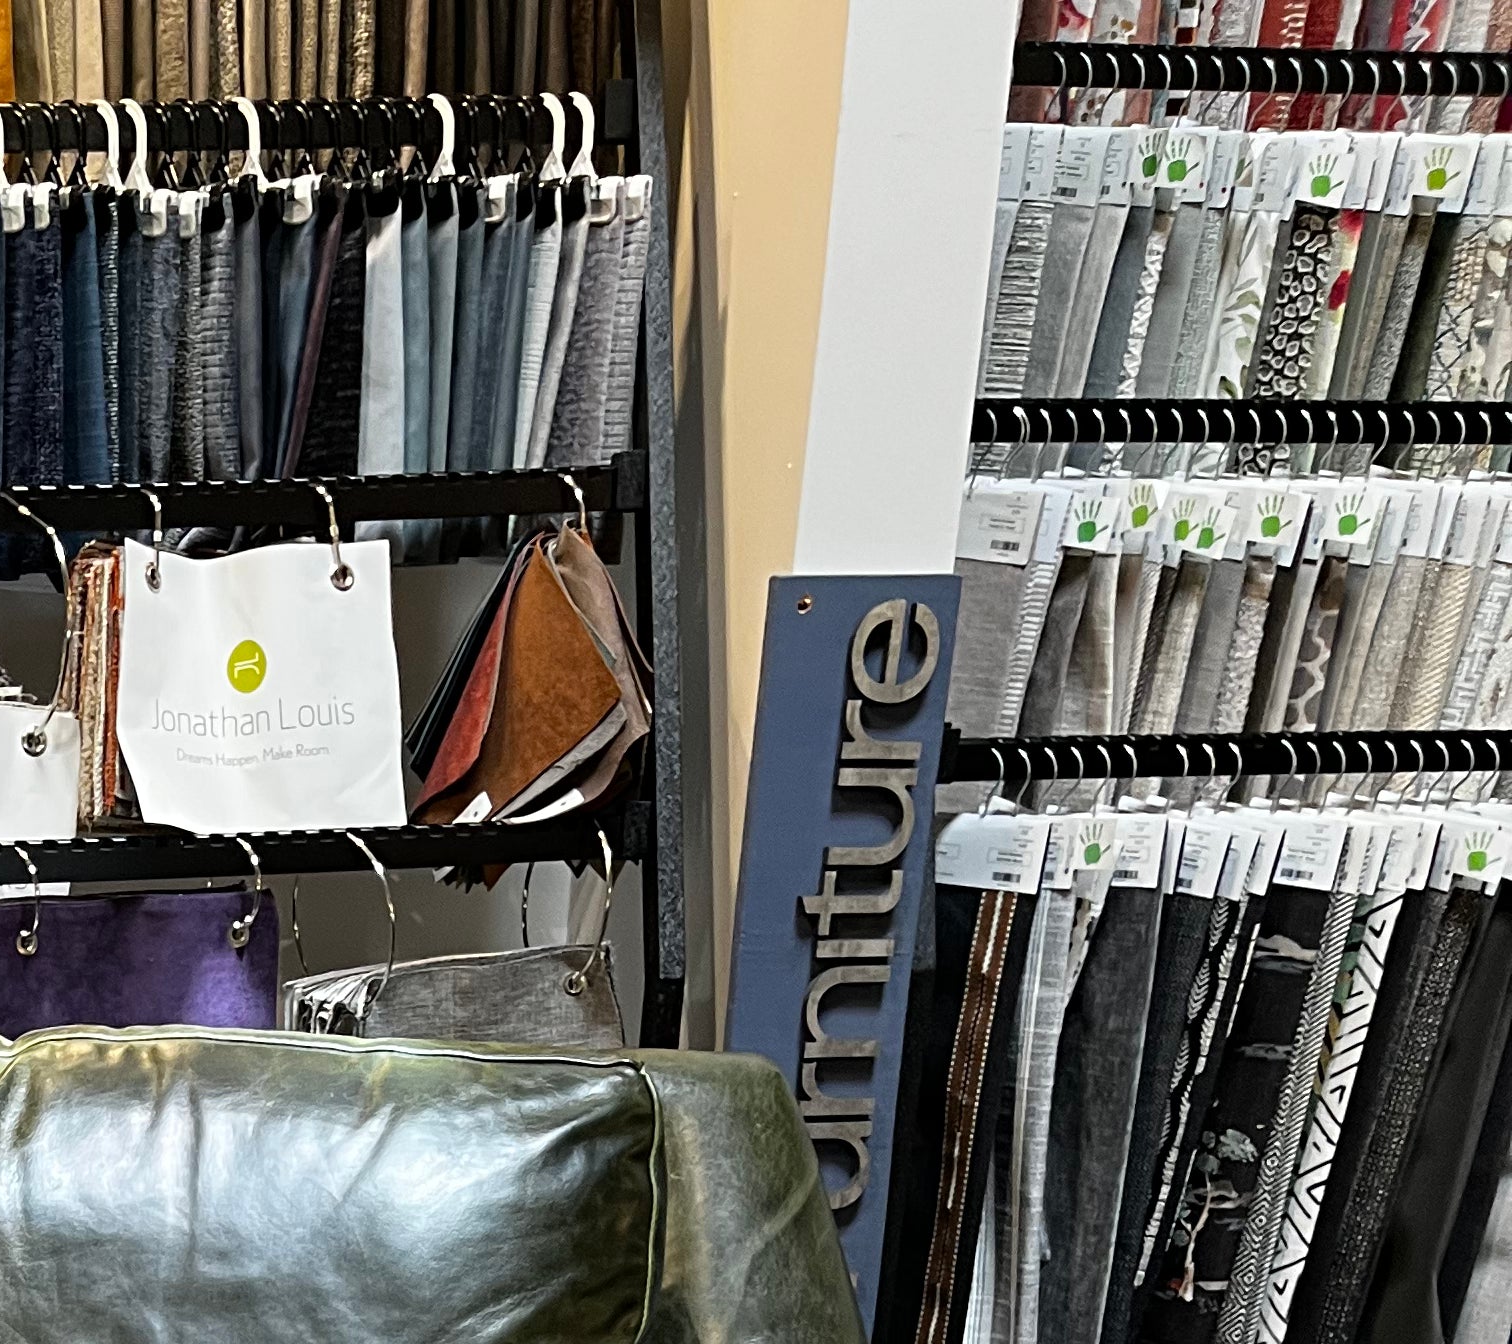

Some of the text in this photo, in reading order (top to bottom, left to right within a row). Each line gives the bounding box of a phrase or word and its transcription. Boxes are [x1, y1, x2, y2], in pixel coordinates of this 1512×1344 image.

[152, 696, 355, 738] Jonathan Louis
[262, 746, 294, 761] Make
[295, 743, 330, 758] Room
[801, 598, 940, 1212] urniture
